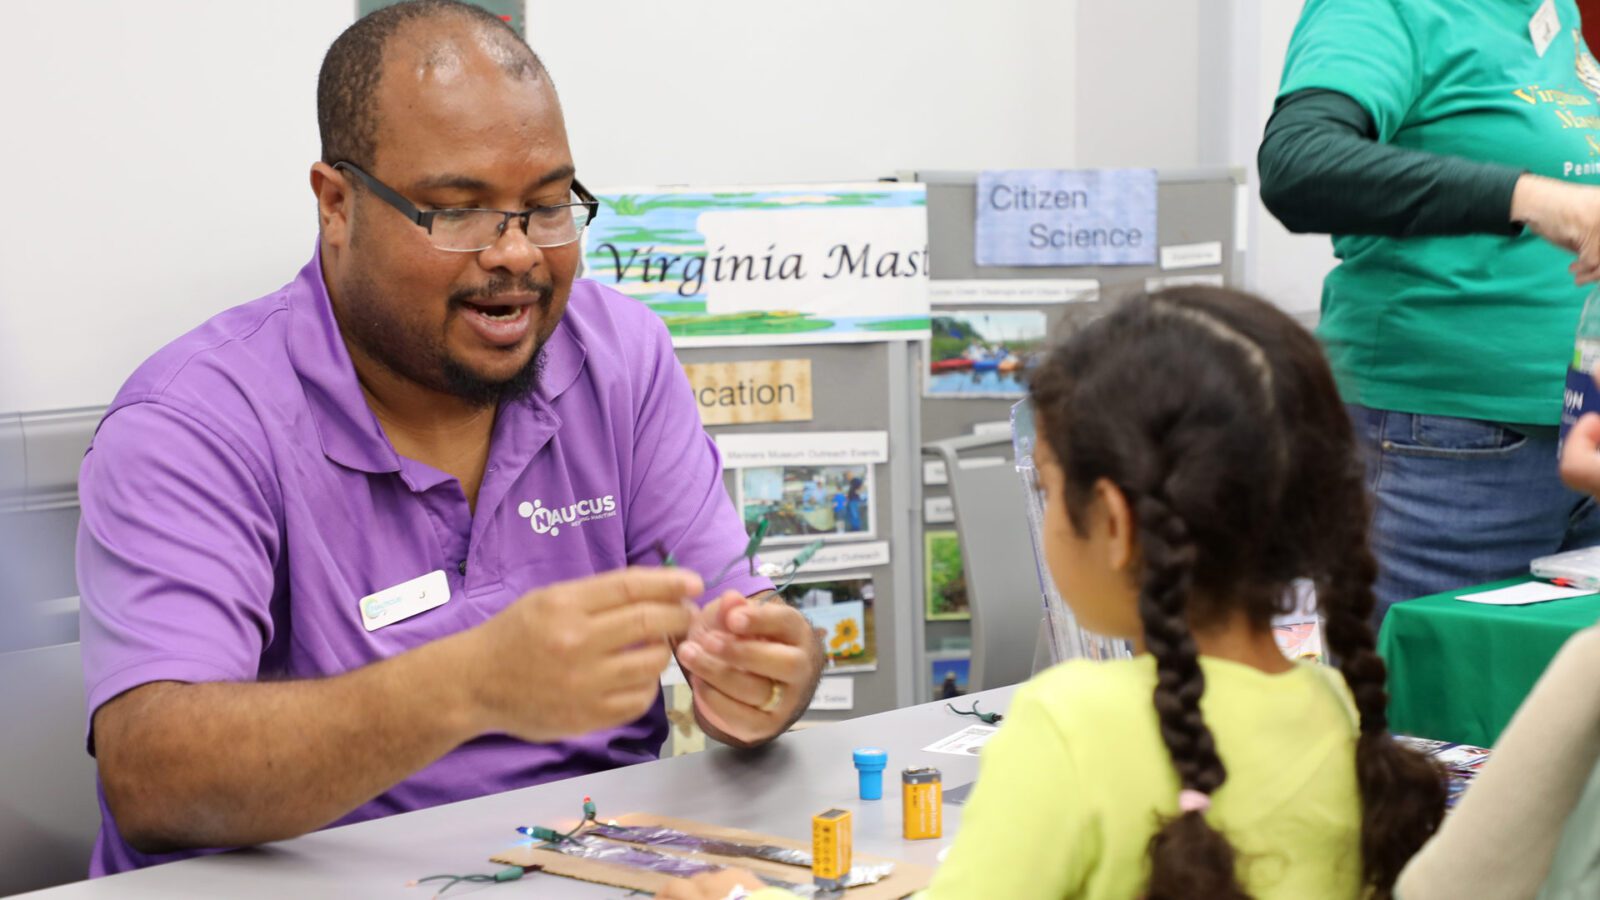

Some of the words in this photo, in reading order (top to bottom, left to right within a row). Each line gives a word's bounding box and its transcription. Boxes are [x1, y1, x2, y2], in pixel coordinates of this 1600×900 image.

[989, 184, 1089, 211] Citizen
[1029, 222, 1143, 249] Science
[595, 242, 807, 297] Virginia
[808, 448, 847, 458] Outreach
